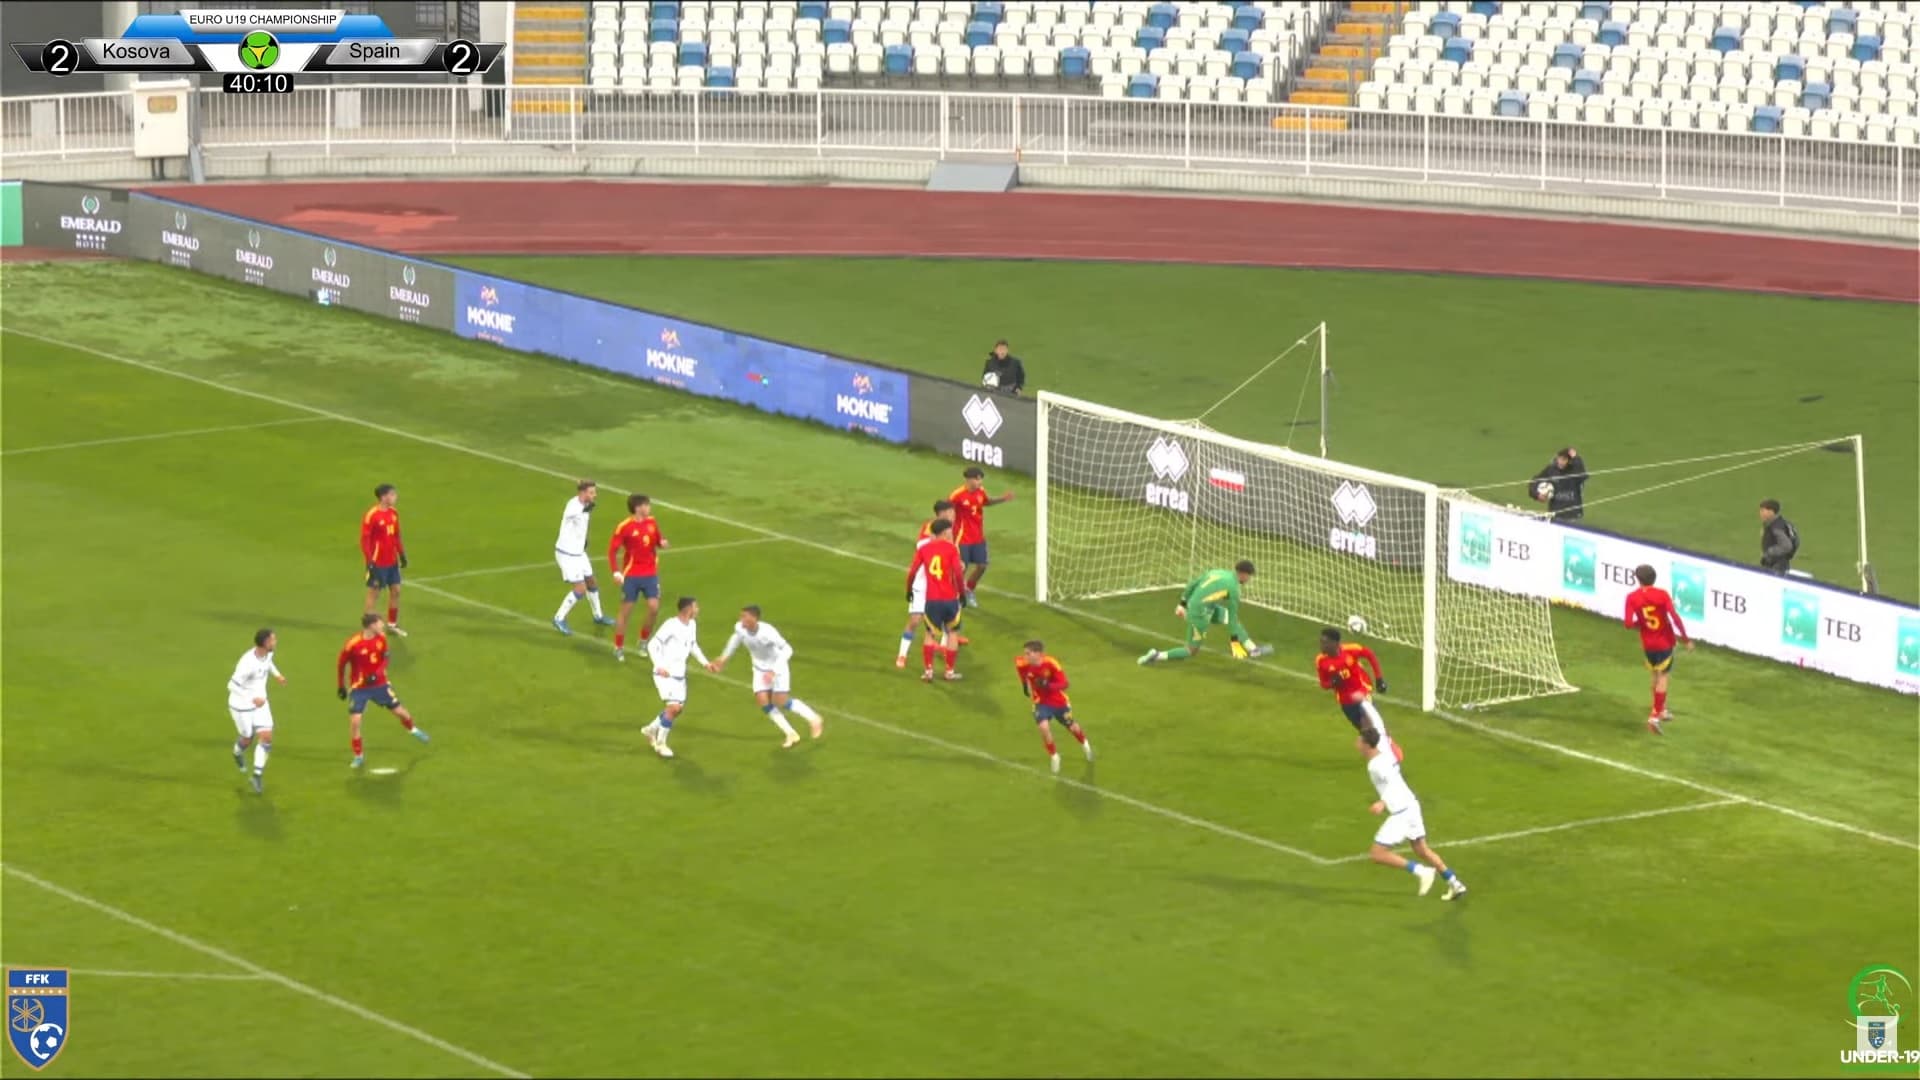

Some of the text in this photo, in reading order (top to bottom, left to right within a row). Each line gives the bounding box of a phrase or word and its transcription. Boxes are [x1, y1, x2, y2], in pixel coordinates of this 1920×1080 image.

[61, 216, 121, 234] EMERALD
[76, 239, 105, 250] HOTEL
[162, 230, 200, 250] EMERALD
[236, 249, 273, 270] EMERALD
[312, 268, 350, 289] EMERALD
[390, 285, 429, 307] EMERALD
[467, 305, 513, 334] MOKNE
[646, 347, 696, 378] MOKNE
[836, 393, 890, 425] MOKNE
[962, 438, 1003, 467] errea
[1145, 482, 1189, 513] errea
[1329, 527, 1376, 559] errea
[1495, 537, 1531, 562] TEB
[929, 554, 943, 580] 4
[1601, 561, 1637, 587] TEB
[1711, 588, 1747, 614] TEB
[1642, 605, 1661, 630] 5
[1824, 617, 1862, 643] TEB
